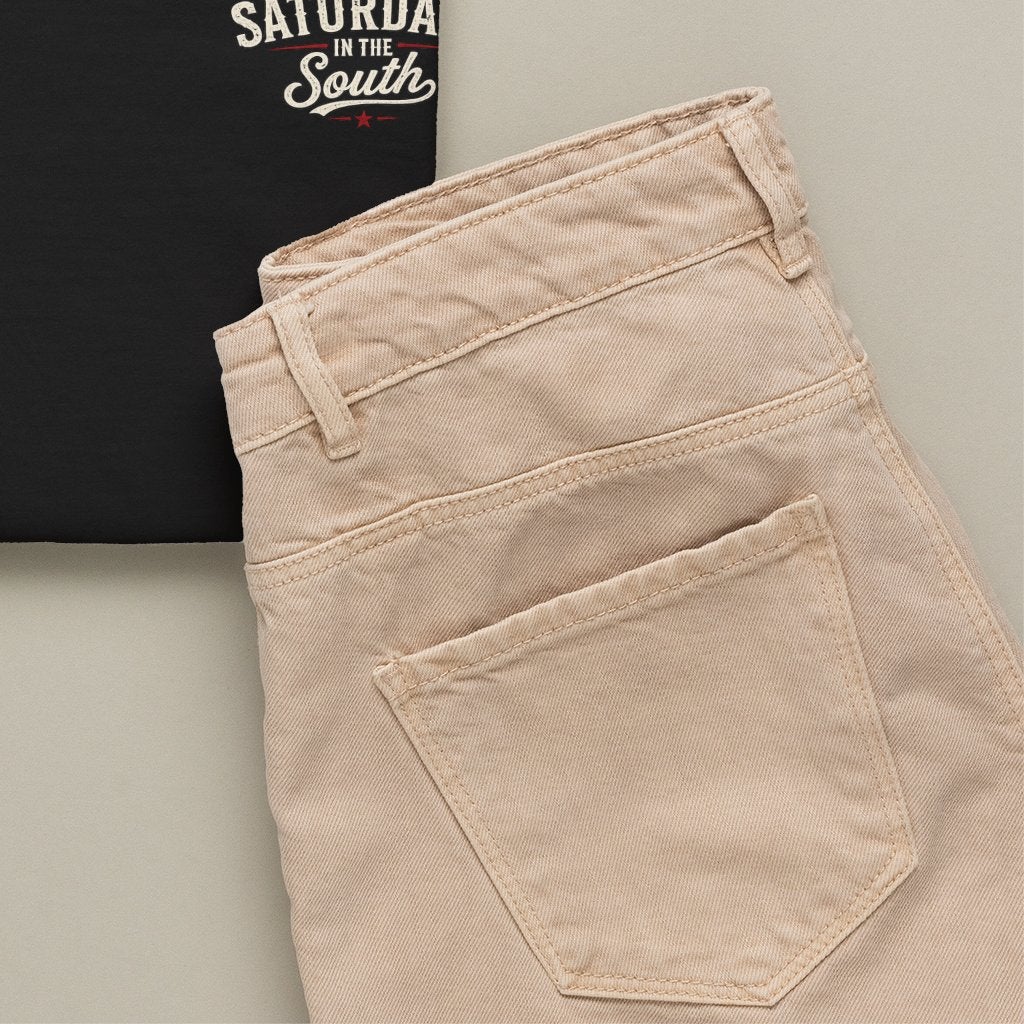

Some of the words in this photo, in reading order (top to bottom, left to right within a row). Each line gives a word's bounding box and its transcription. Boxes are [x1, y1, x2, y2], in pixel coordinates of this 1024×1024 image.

[334, 38, 352, 56] IN
[358, 38, 393, 56] THE
[283, 51, 436, 117] South
